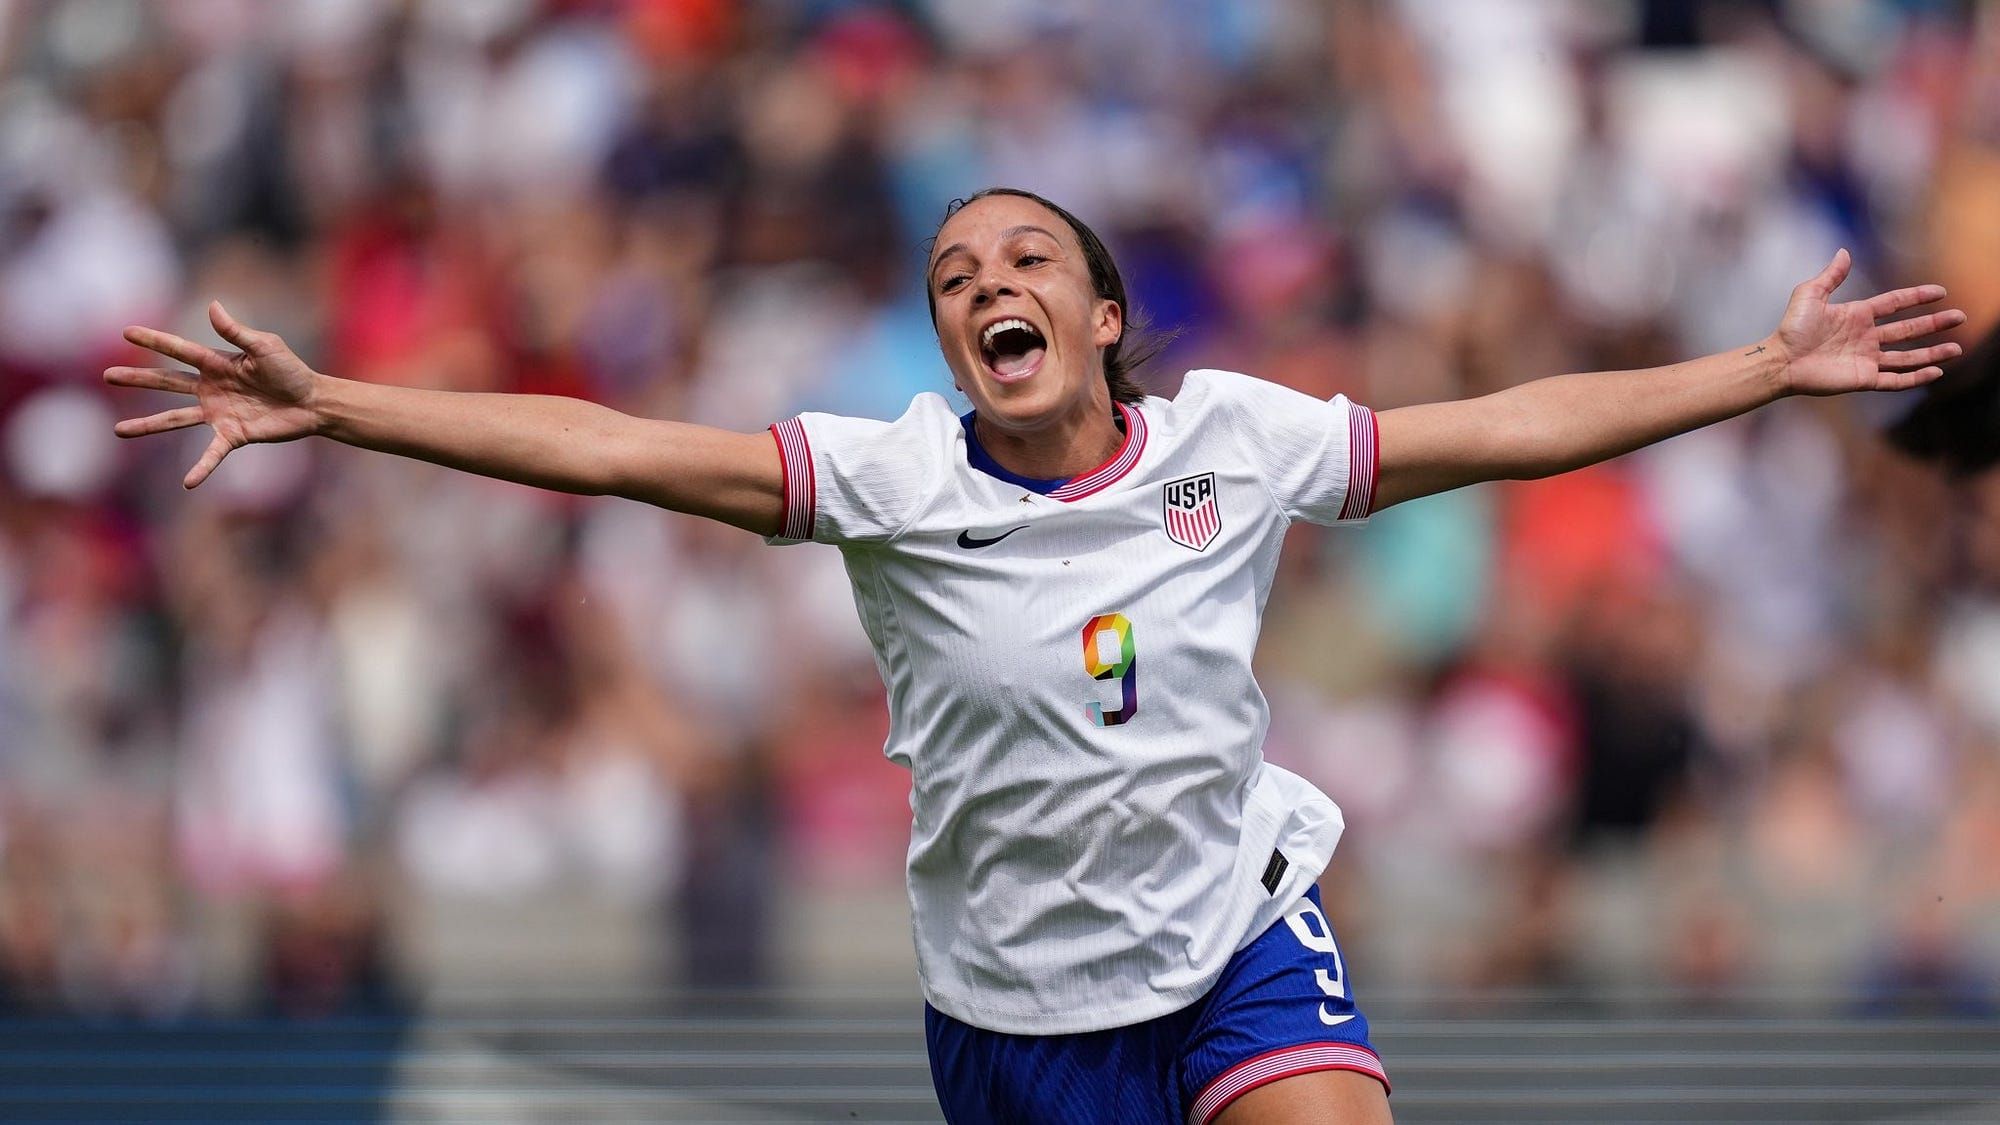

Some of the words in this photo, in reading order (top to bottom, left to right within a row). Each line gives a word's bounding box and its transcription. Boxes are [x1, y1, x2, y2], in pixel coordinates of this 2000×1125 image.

[1168, 478, 1211, 509] USA
[1081, 612, 1138, 728] 9
[1283, 896, 1345, 999] 9
